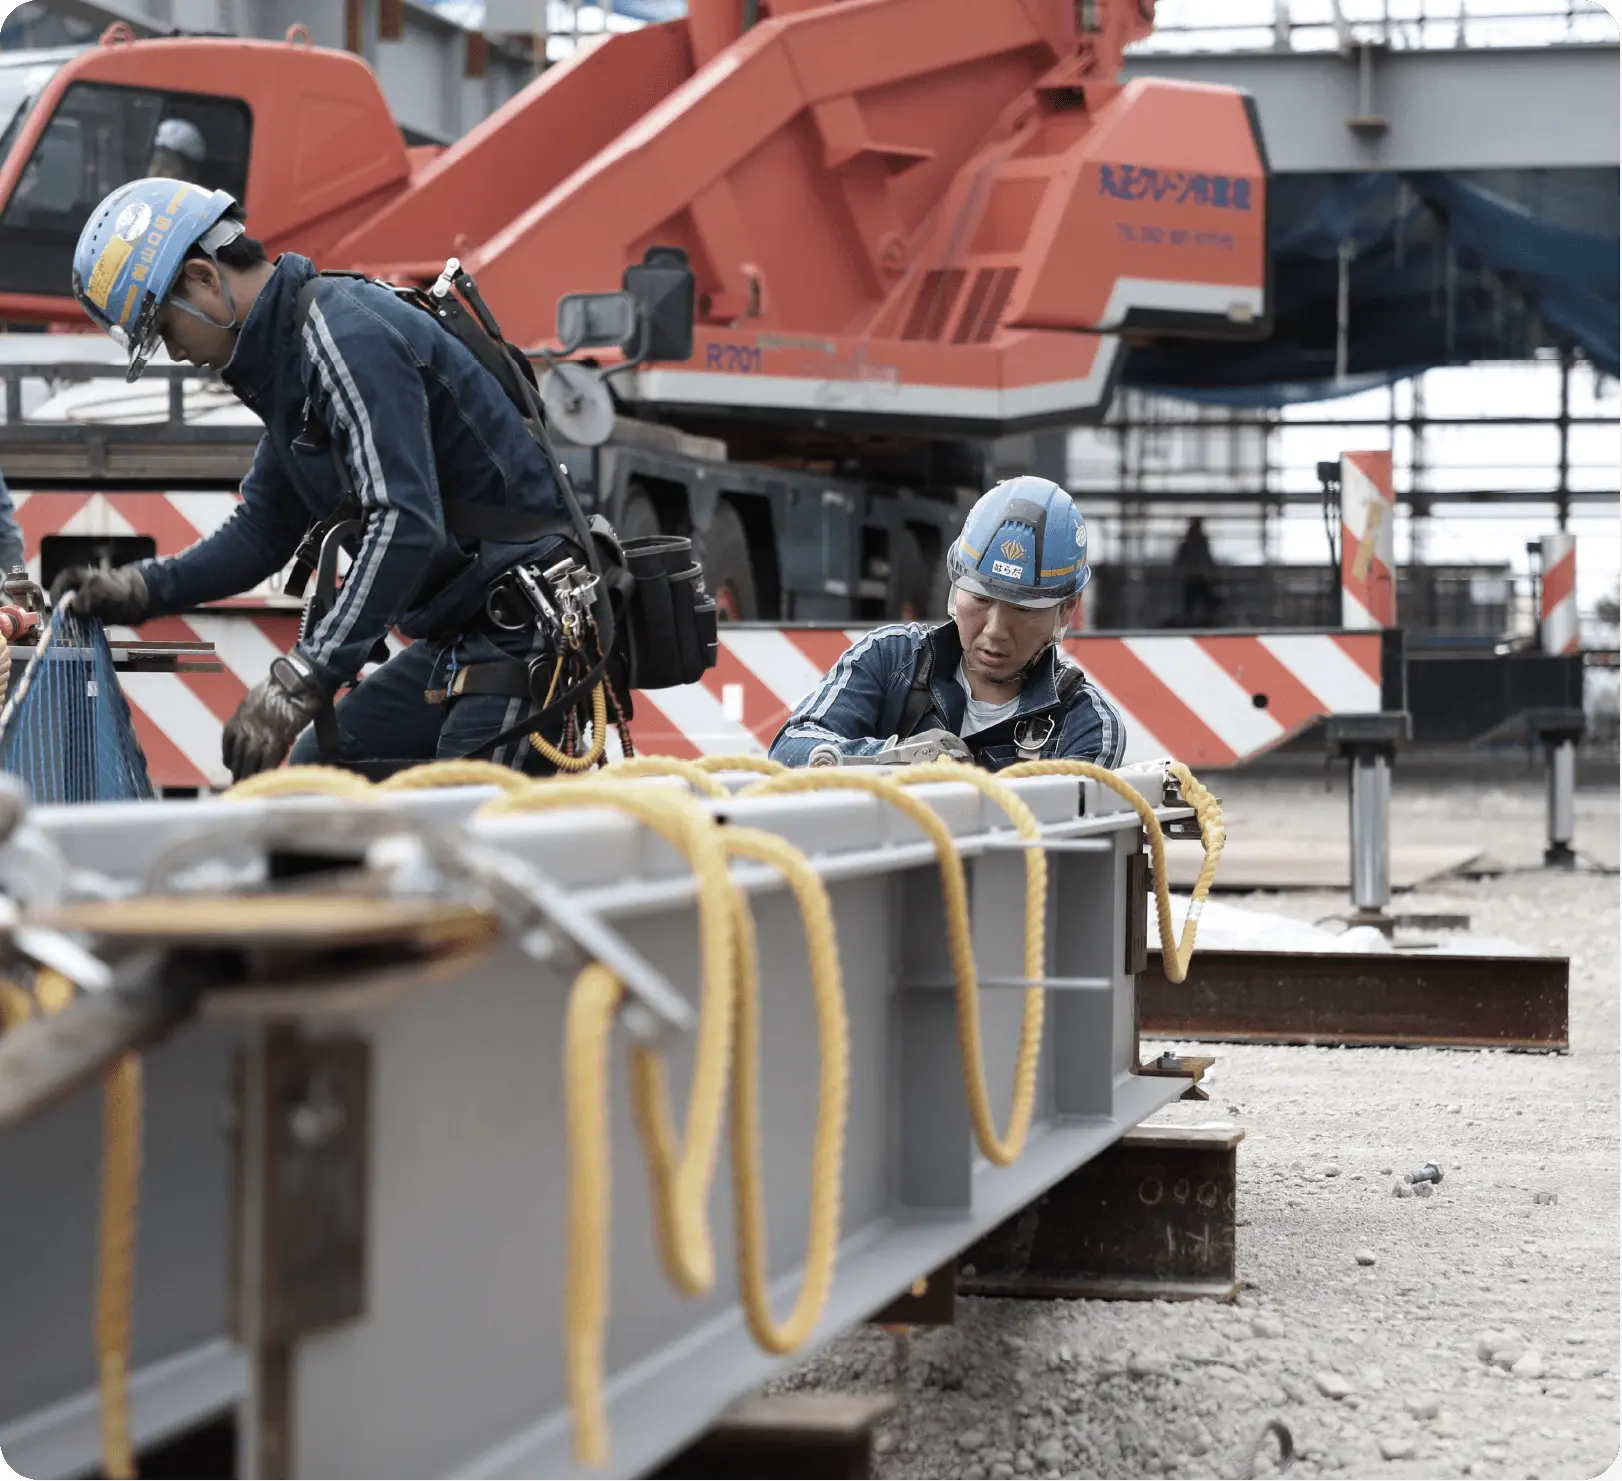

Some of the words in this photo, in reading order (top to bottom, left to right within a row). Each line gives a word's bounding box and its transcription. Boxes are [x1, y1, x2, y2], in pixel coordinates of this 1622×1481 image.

[706, 342, 761, 373] R701
[993, 563, 1022, 578] はらだ
